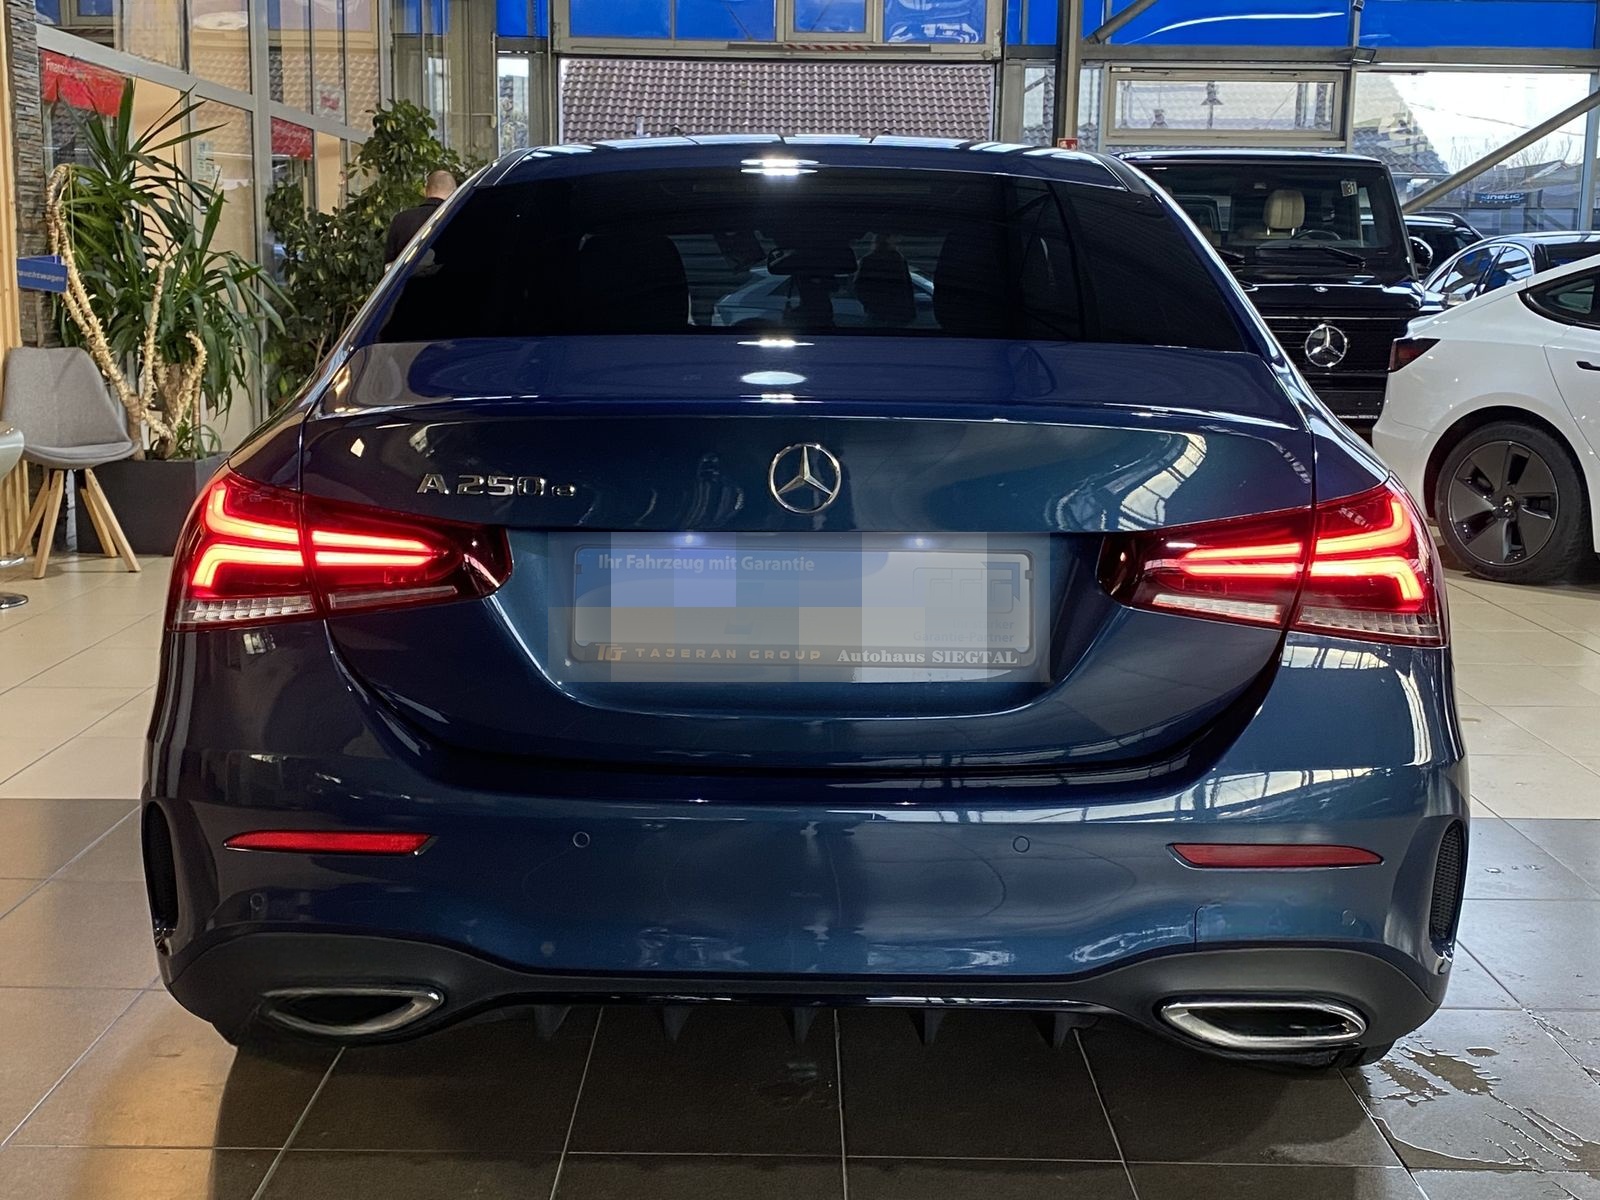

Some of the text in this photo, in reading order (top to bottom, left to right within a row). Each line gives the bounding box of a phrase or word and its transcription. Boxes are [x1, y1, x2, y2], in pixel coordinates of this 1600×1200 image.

[416, 473, 449, 495] A
[456, 474, 546, 496] 250
[598, 554, 815, 573] Ihr Fahrzeug mit Garantie
[635, 648, 736, 659] TAJERAN
[749, 650, 820, 660] GROUP
[837, 649, 1018, 664] Autohaus SIEGTAL
